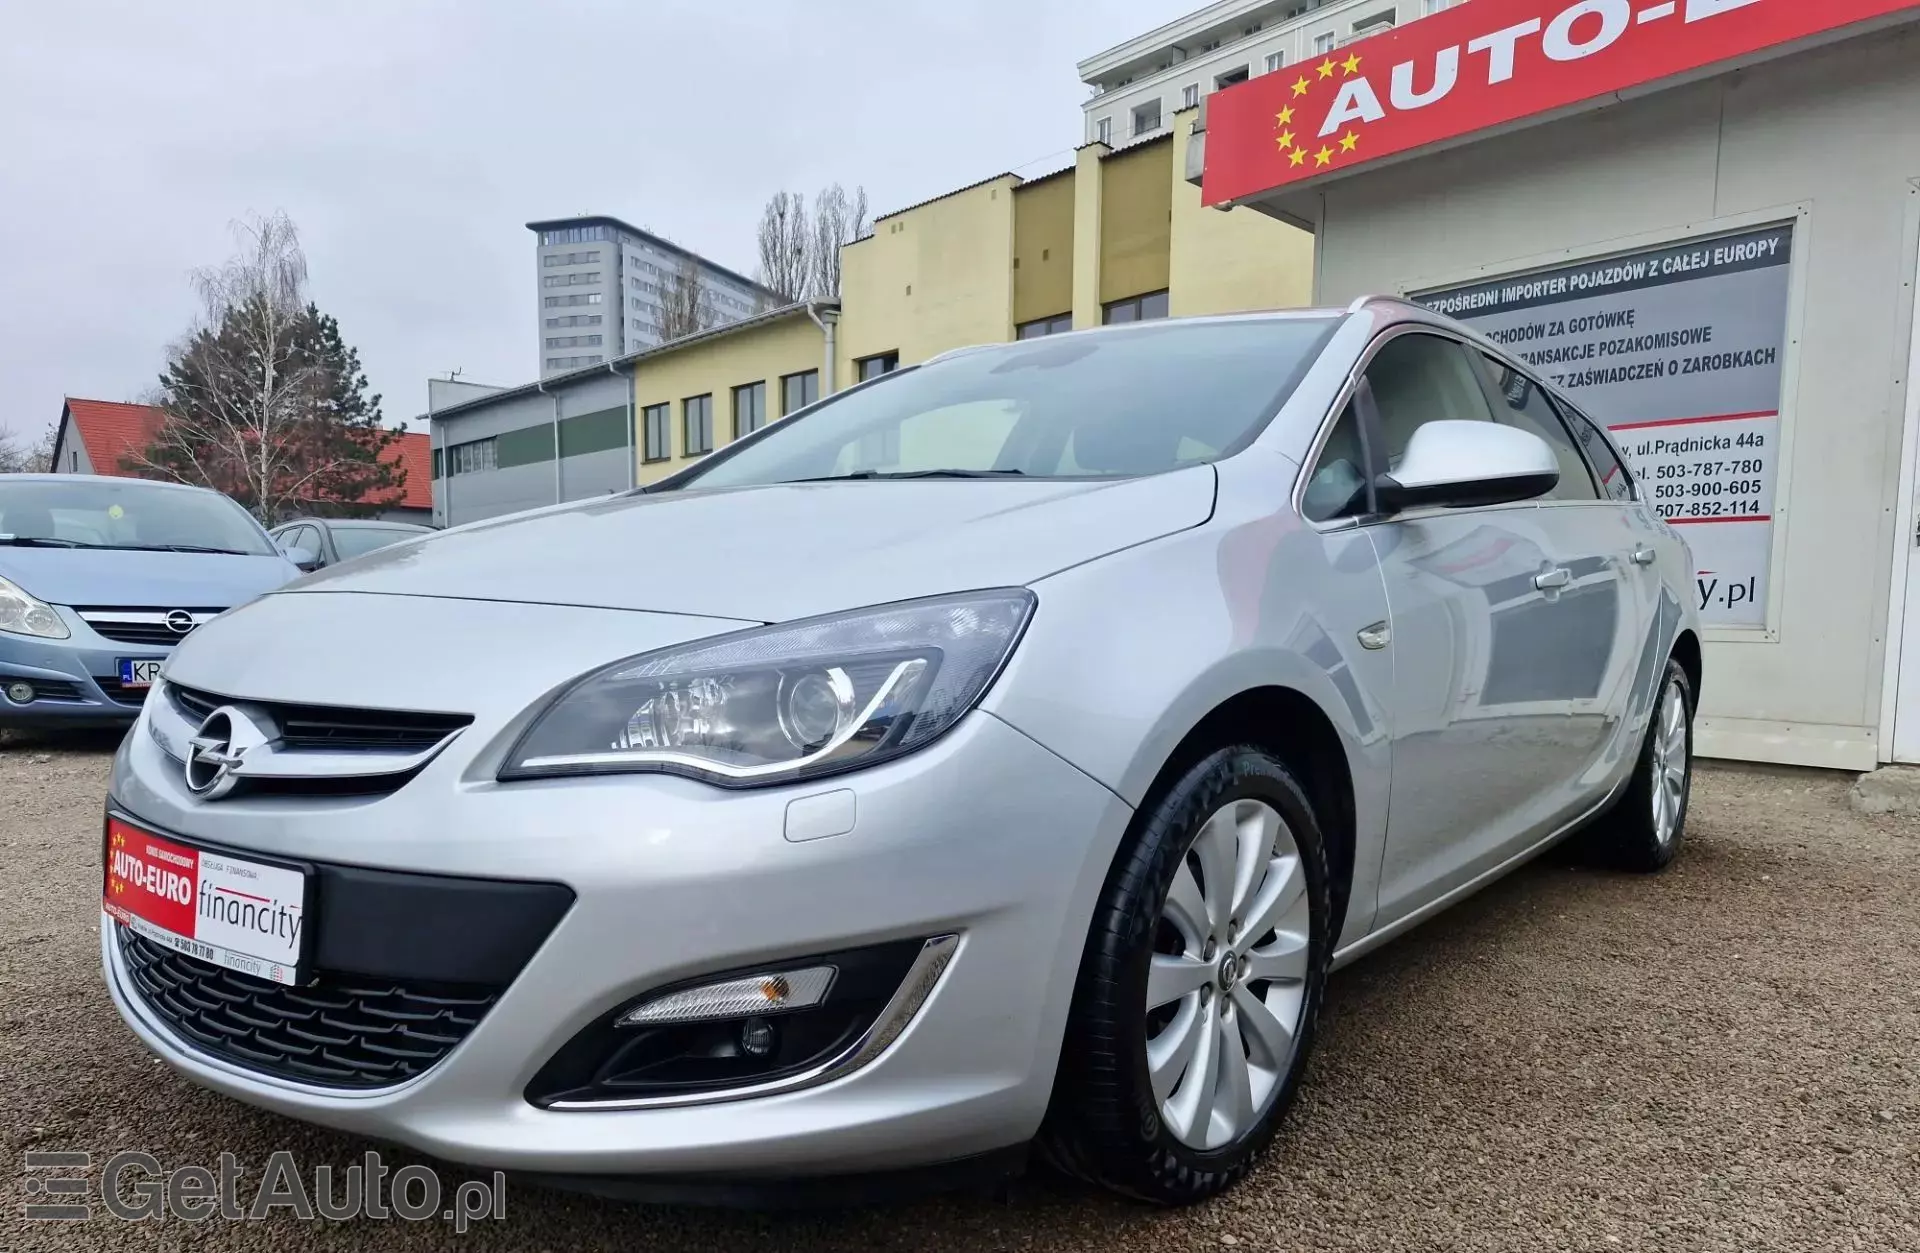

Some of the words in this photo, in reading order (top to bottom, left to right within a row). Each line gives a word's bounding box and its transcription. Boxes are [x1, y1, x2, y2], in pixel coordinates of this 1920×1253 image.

[1502, 278, 1566, 303] IMPORTER
[1570, 262, 1645, 291] POJAZDÓW
[1648, 260, 1659, 277] Z
[1662, 250, 1710, 274] CAŁEJ
[1714, 237, 1779, 265] EUROPY
[1548, 320, 1565, 338] ZA
[1568, 308, 1635, 334] GOTÓWKĘ
[1599, 326, 1712, 357] POZAKOMISOWE
[1568, 358, 1663, 389] ZAŚWIADCZEŃ
[1668, 360, 1678, 376] O
[1681, 347, 1776, 374] ZAROBKACH
[1637, 435, 1731, 456] ul.Prądnicka
[1736, 432, 1765, 448] 44a
[1657, 459, 1762, 479] 503-787-780
[1655, 480, 1761, 498] 503-900-605
[1655, 500, 1760, 517] 507-852-114
[113, 850, 192, 905] AUTO-EURO
[199, 880, 302, 949] financity
